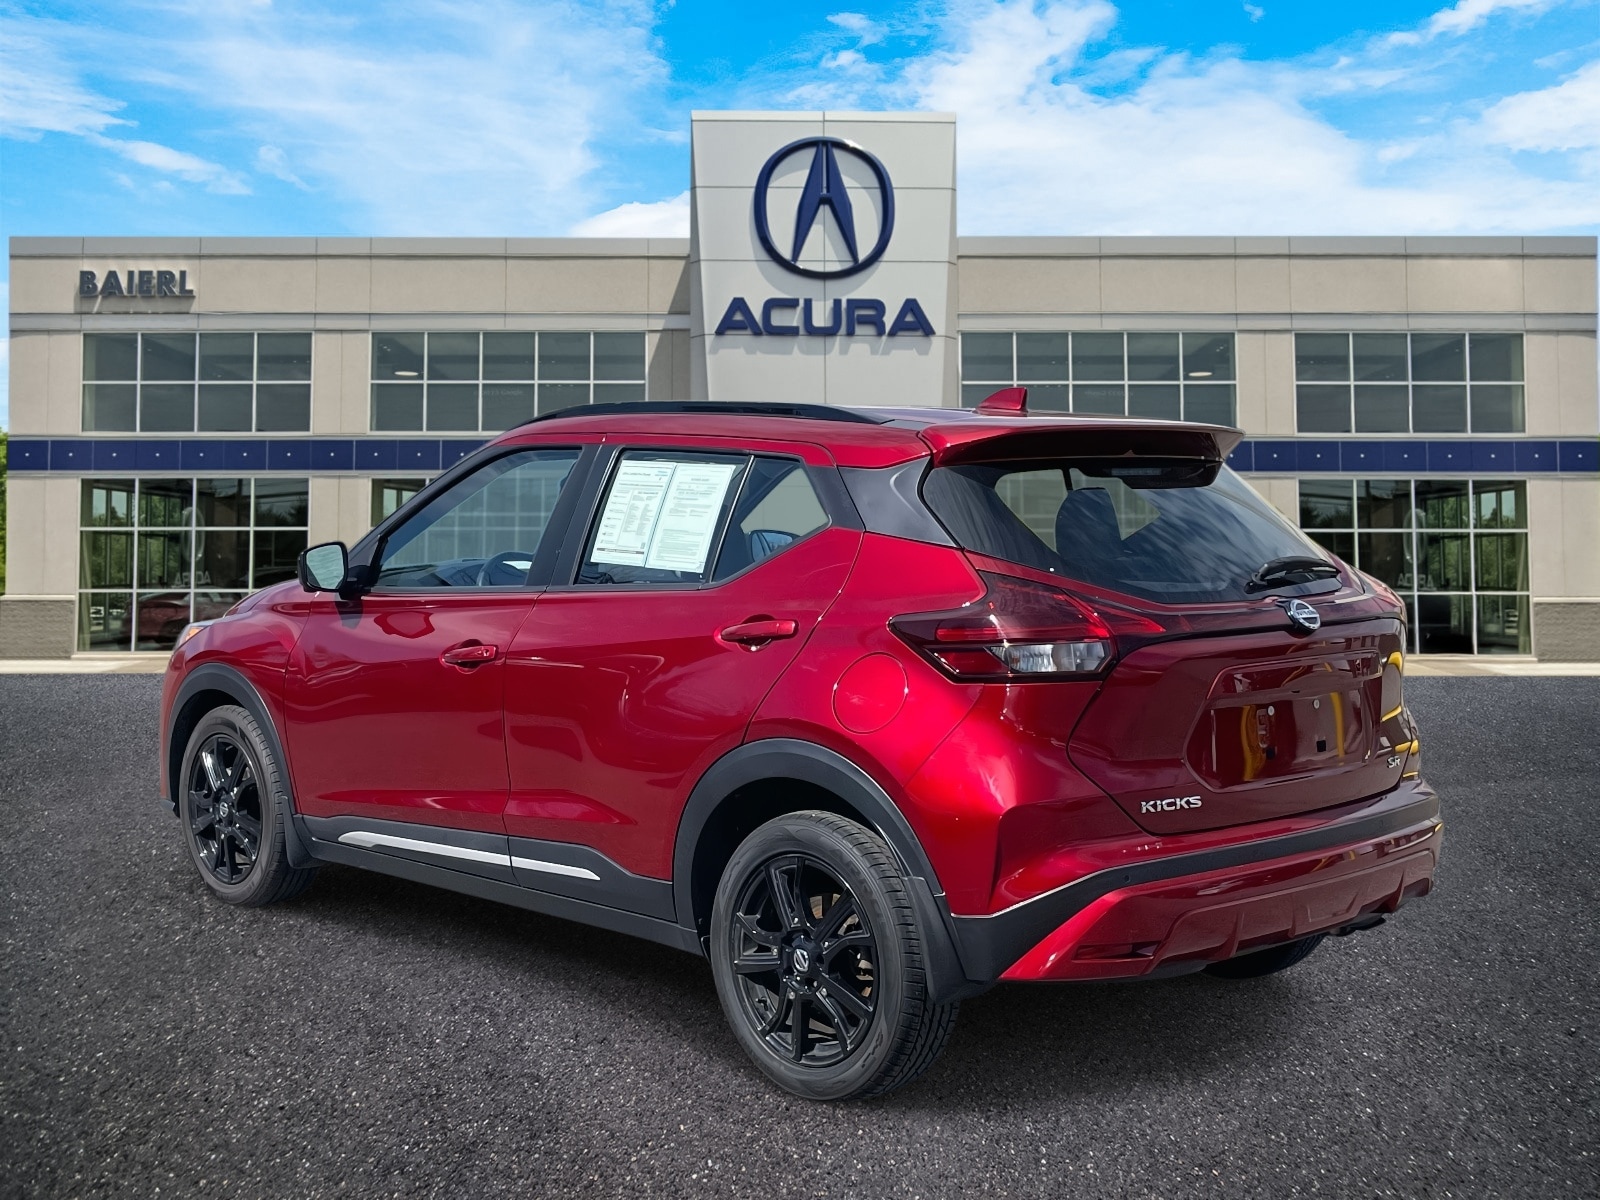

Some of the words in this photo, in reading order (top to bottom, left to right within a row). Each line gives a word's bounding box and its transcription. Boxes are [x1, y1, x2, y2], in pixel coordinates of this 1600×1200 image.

[79, 270, 194, 297] BAIERL
[715, 297, 935, 336] ACURA
[1397, 573, 1434, 587] ACRA
[1140, 796, 1202, 813] KICKS
